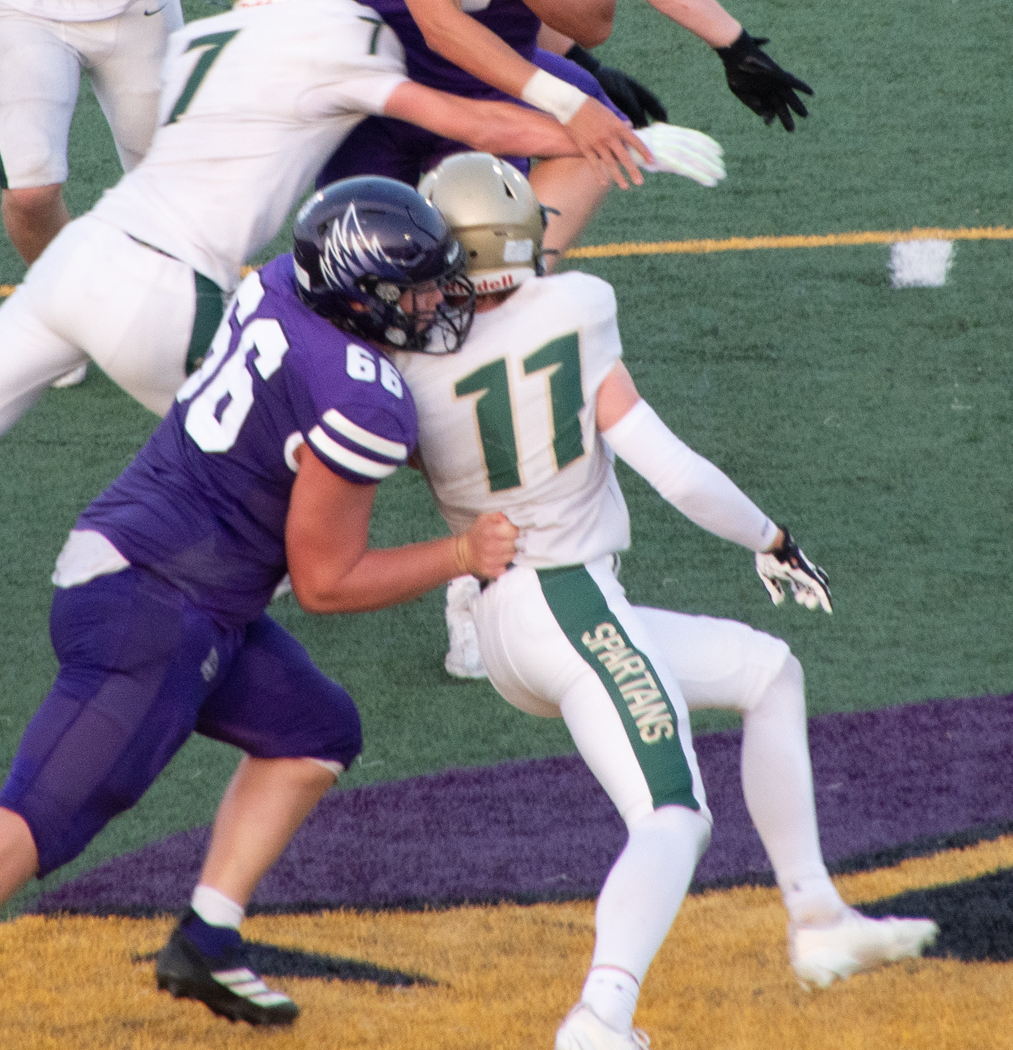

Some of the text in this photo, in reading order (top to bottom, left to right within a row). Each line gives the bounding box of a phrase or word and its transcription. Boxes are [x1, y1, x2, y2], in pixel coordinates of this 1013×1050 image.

[165, 28, 244, 128] 7
[358, 15, 384, 56] 7
[345, 343, 404, 400] 66
[452, 326, 588, 495] 11
[580, 621, 675, 746] SPARTANS
